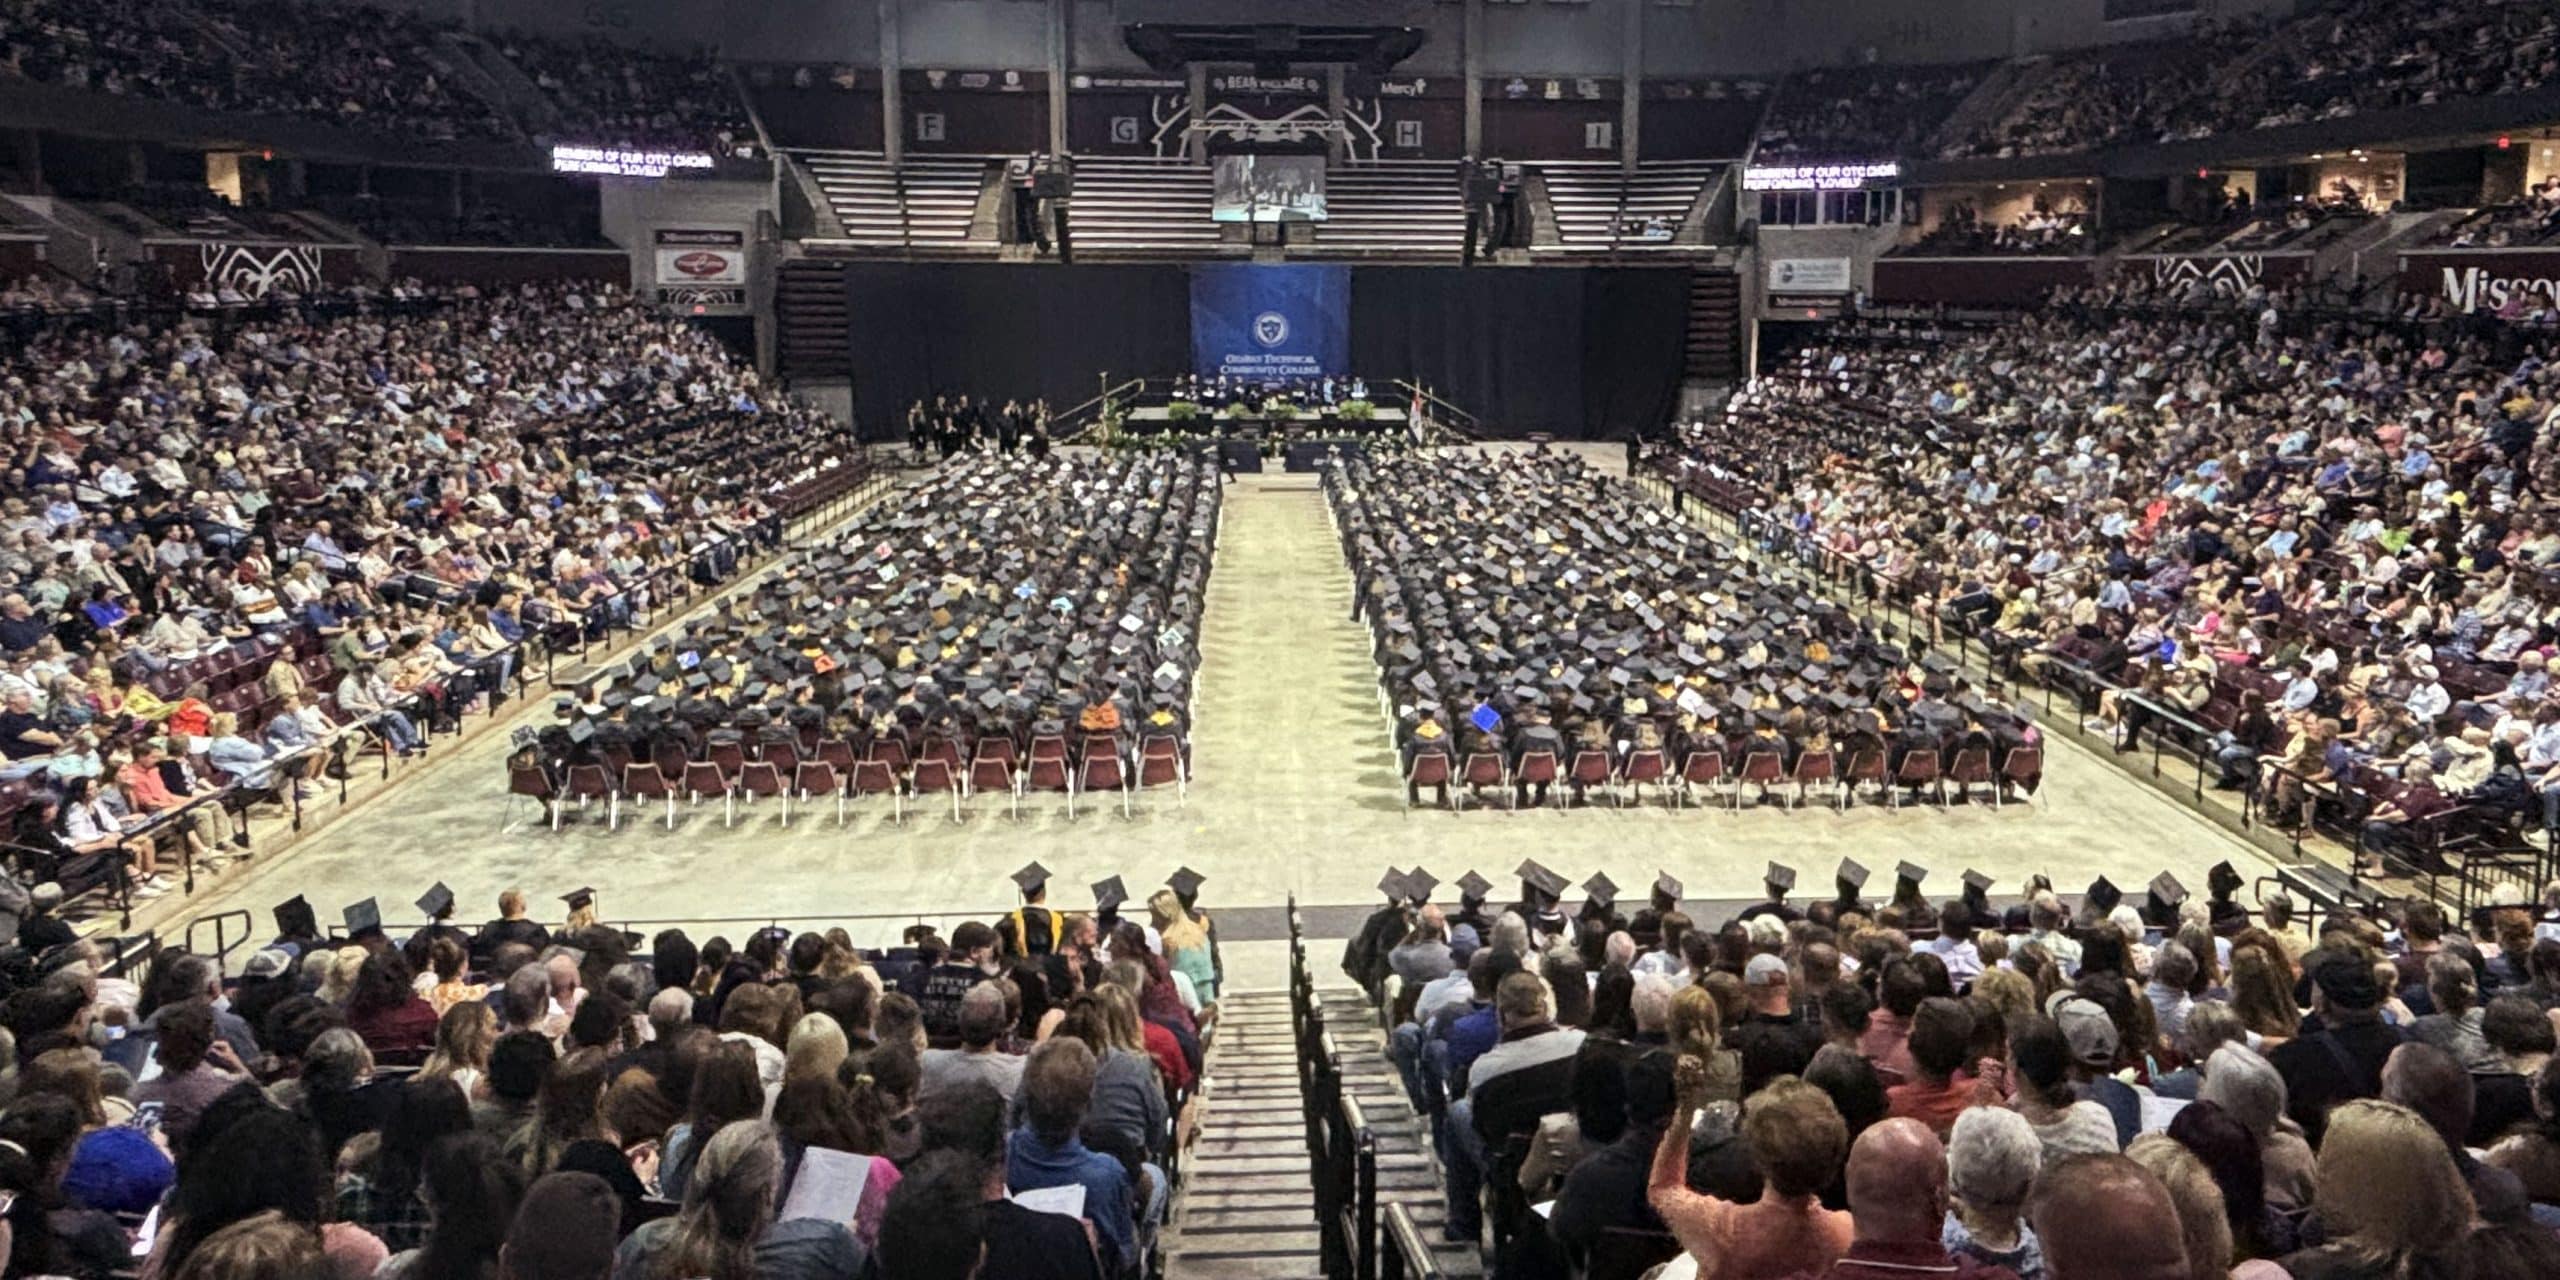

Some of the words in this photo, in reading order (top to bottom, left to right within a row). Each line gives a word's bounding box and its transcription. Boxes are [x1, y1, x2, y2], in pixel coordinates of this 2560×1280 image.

[1227, 75, 1257, 89] BEAR
[1381, 81, 1416, 97] Mercy
[553, 147, 603, 161] MEMBERS
[605, 151, 619, 162] OF
[621, 152, 643, 164] OUR
[645, 154, 671, 166] OTC
[673, 155, 713, 168] CHOIR
[554, 159, 620, 174] PERFORMING
[1744, 167, 1797, 179] MEMBERS
[1798, 167, 1814, 178] OF
[1815, 166, 1841, 178] OUR
[1842, 165, 1866, 177] OTC
[1867, 164, 1897, 177] CHOIR
[1743, 178, 1815, 190] PERFORMING
[2441, 266, 2560, 315] Miso
